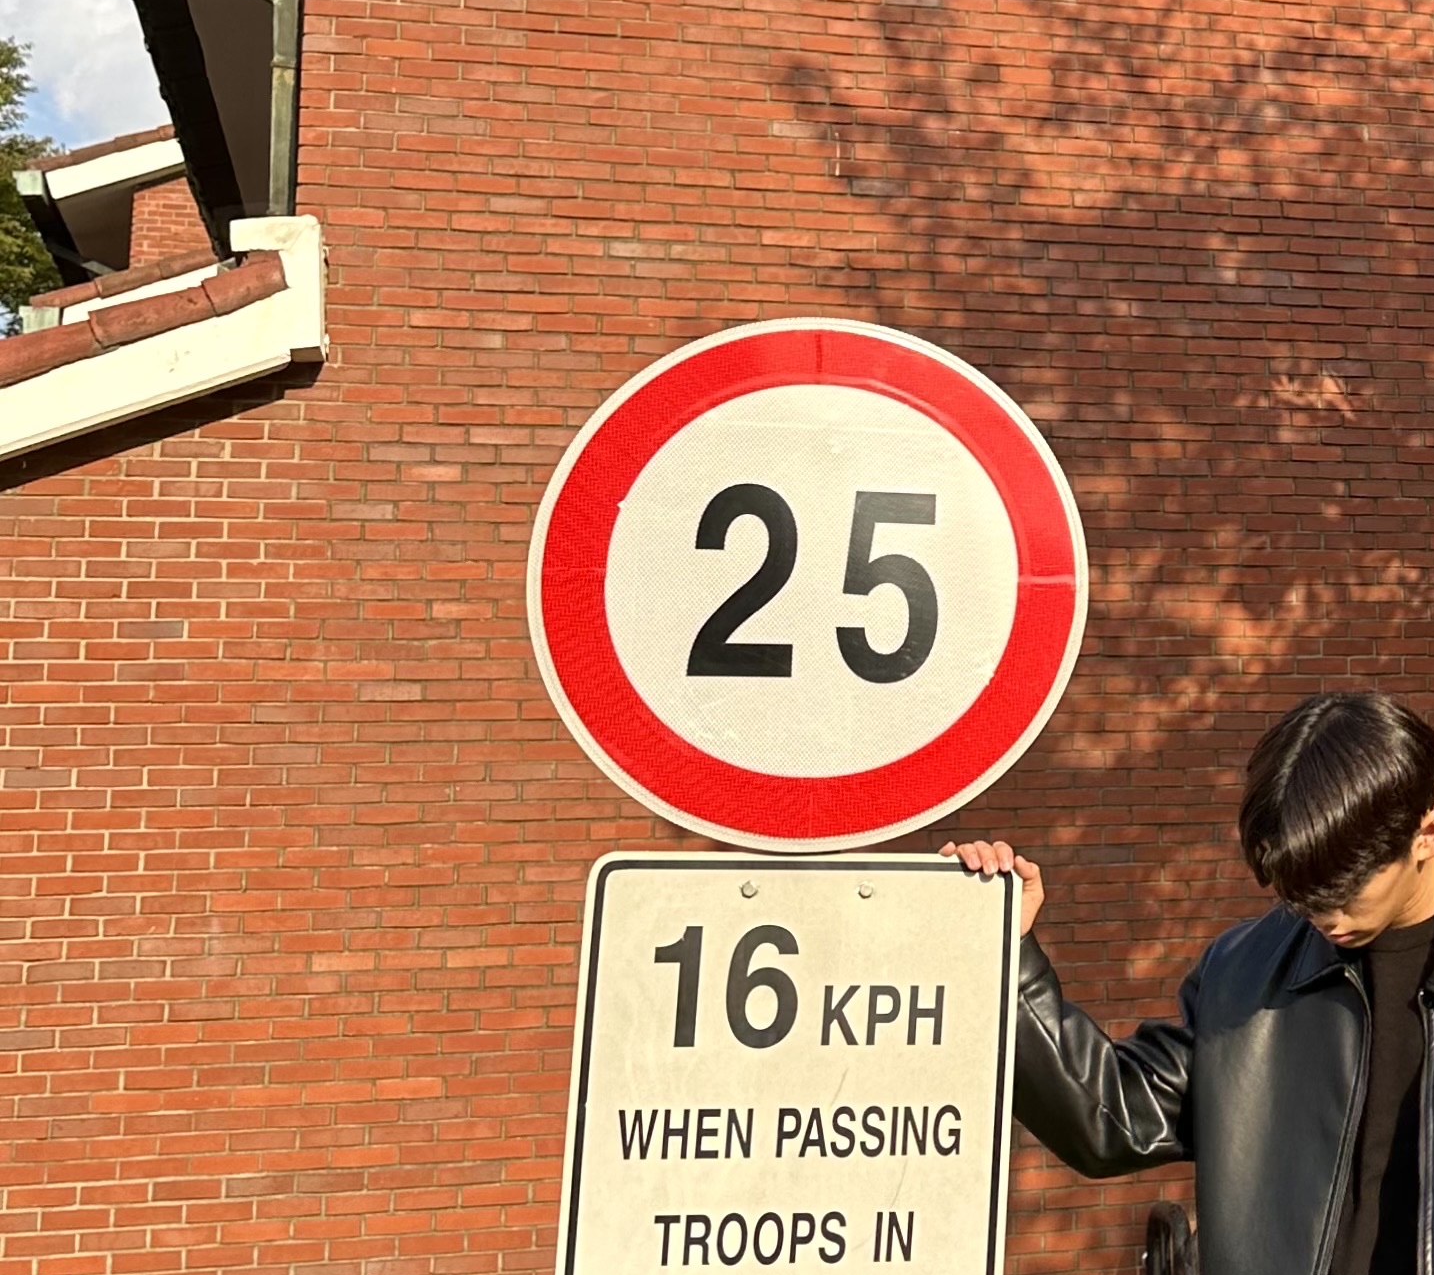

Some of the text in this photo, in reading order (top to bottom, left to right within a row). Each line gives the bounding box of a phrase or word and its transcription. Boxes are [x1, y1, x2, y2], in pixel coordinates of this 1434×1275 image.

[686, 483, 939, 685] 25
[654, 924, 946, 1049] 16 KPH
[618, 1104, 962, 1160] WHEN PASSING
[654, 1211, 915, 1267] TROOPS IN
